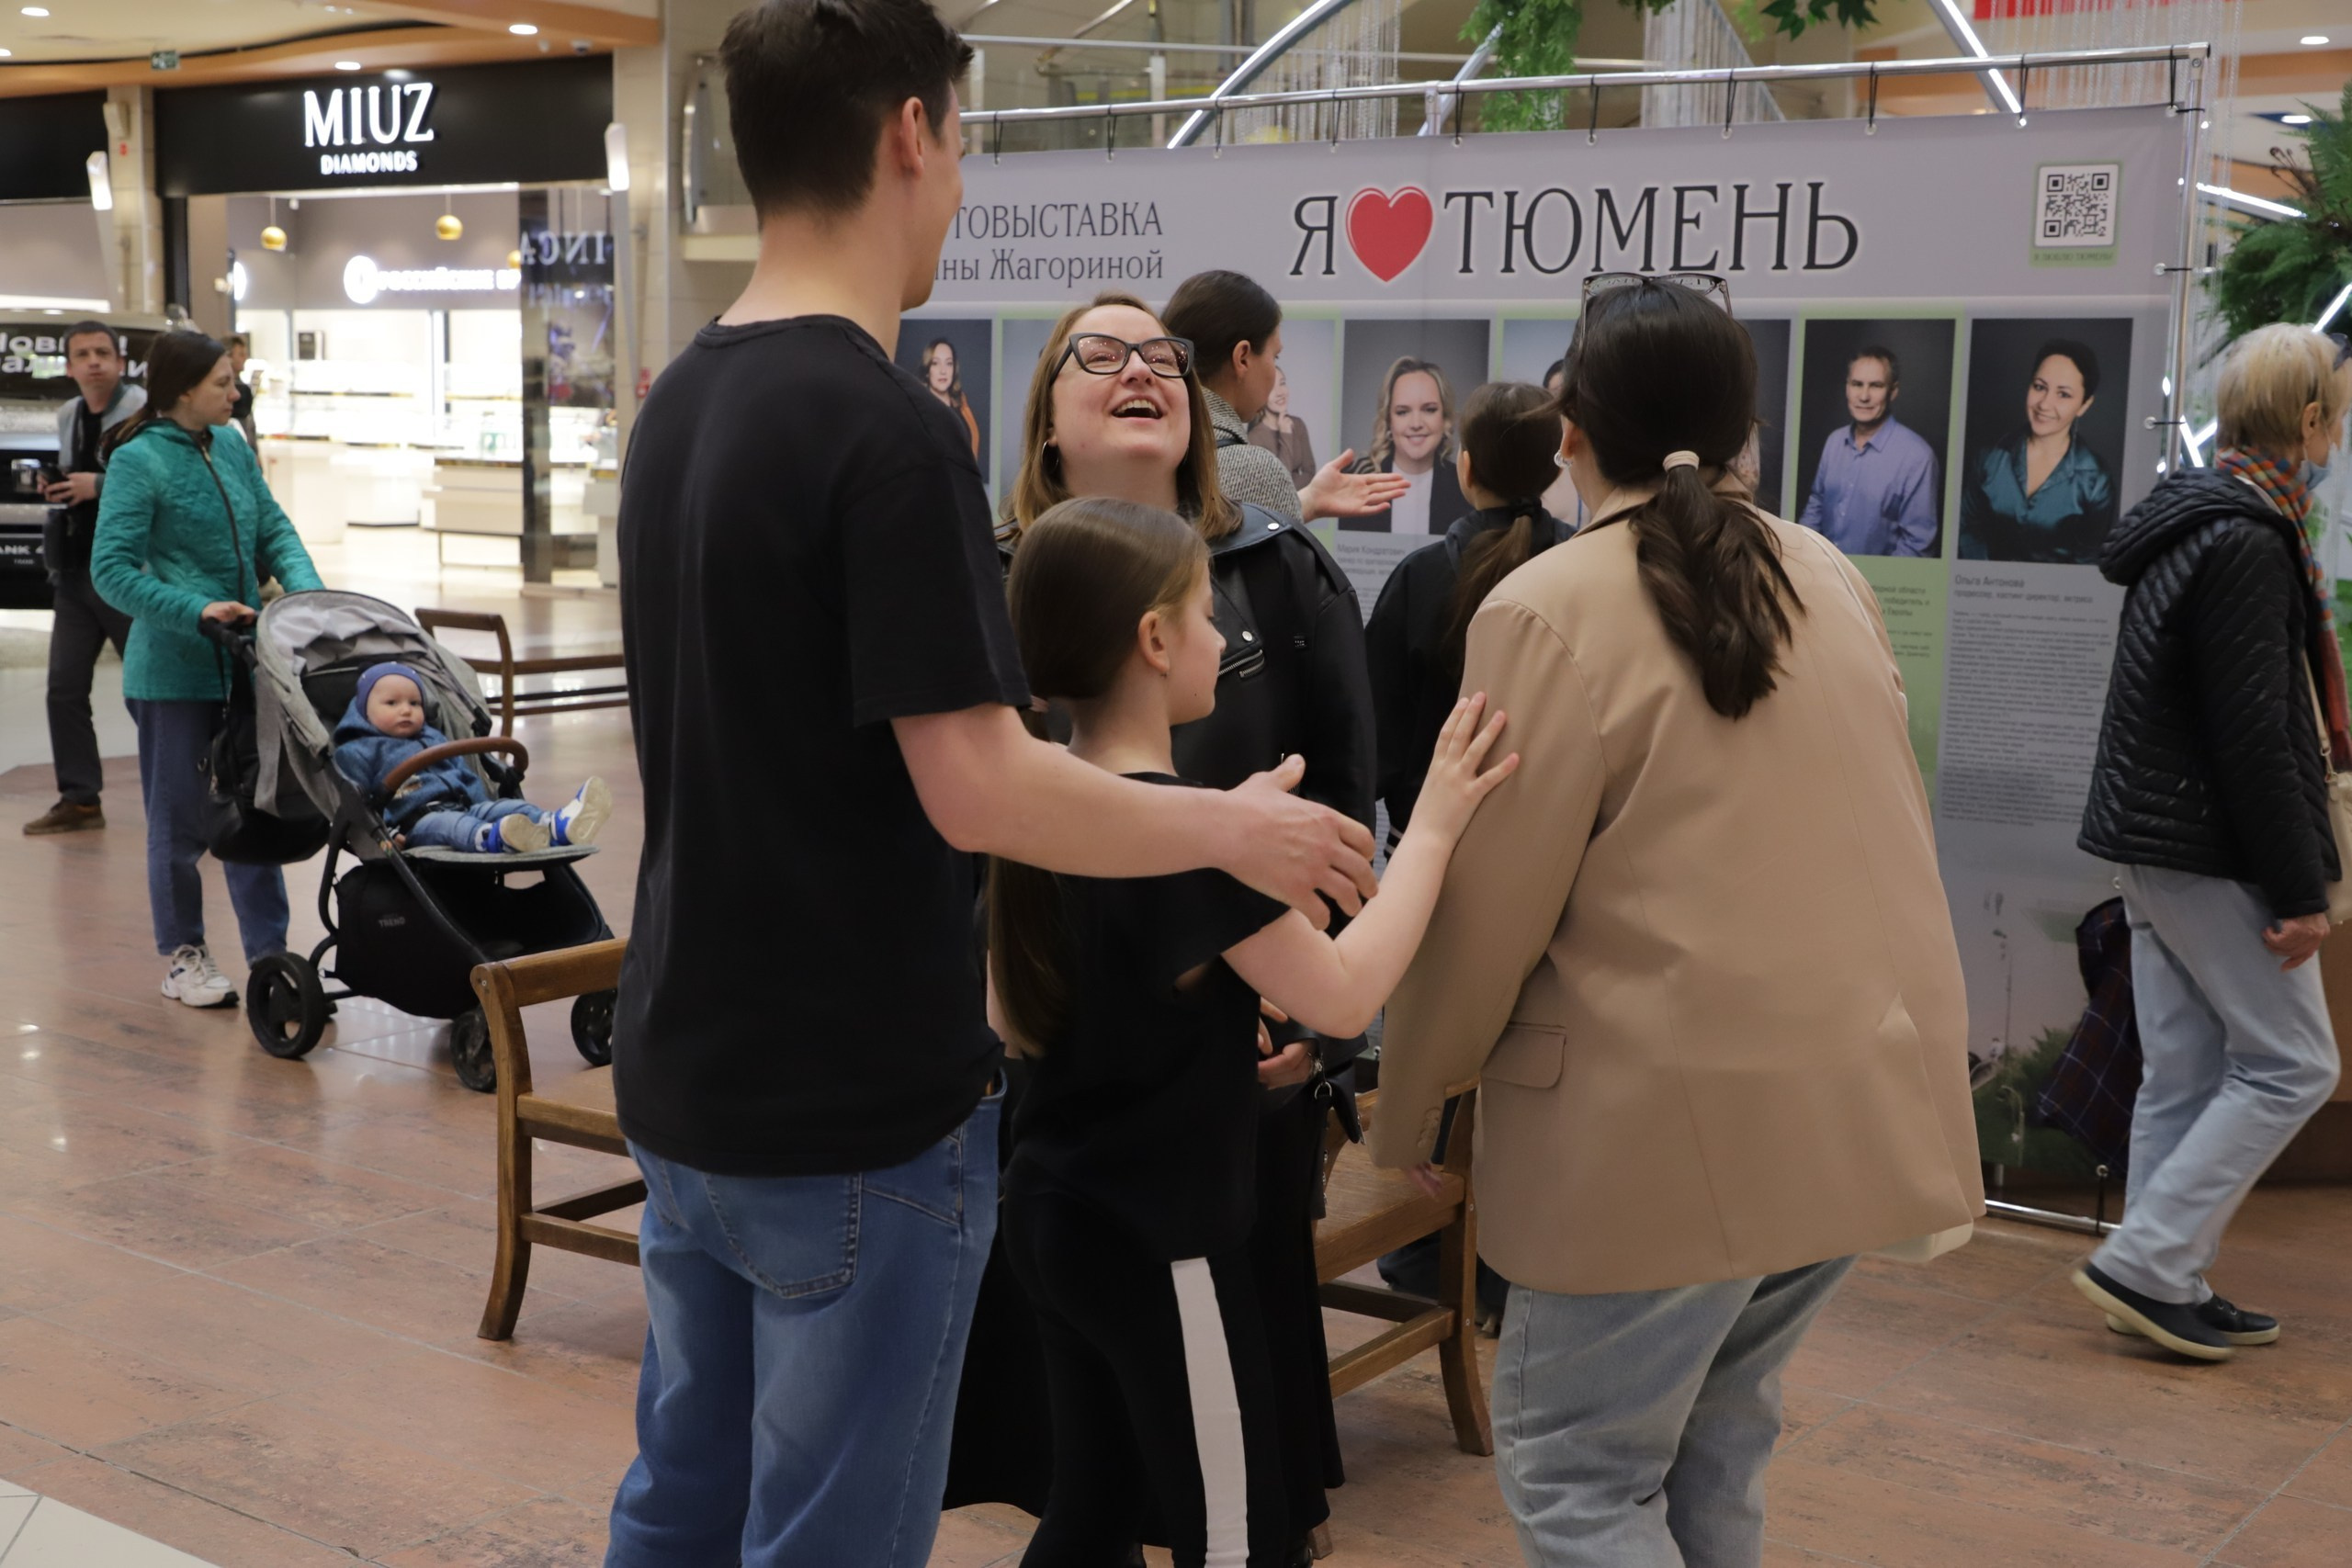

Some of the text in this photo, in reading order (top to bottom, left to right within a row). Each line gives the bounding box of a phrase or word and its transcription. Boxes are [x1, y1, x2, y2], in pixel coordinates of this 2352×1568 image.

[304, 83, 434, 147] MIUZ
[321, 151, 418, 175] DIAMONDS
[955, 201, 1163, 239] ТОВЫСТАВКА
[1290, 182, 1859, 276] Я ТЮМЕНЬ
[989, 249, 1163, 288] Жагориной
[1955, 574, 2025, 588] Ольга Антонова
